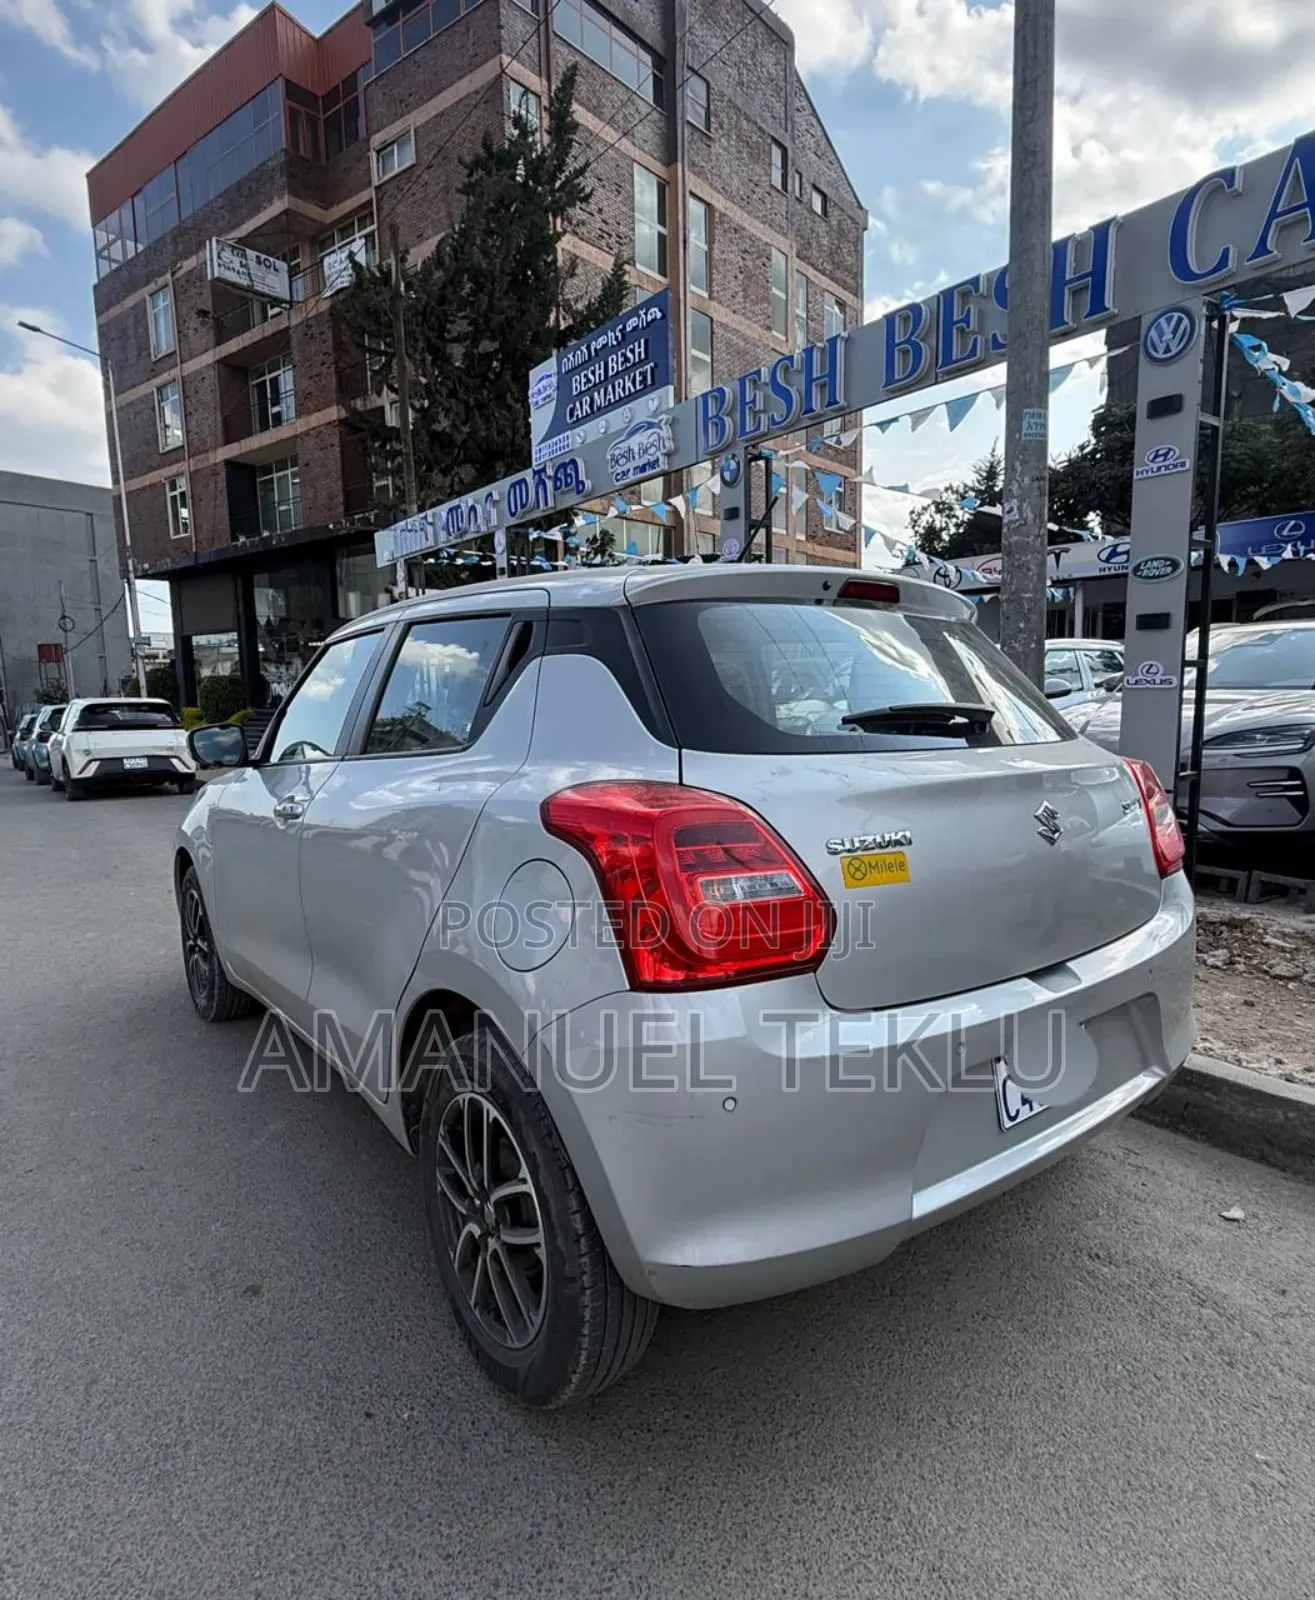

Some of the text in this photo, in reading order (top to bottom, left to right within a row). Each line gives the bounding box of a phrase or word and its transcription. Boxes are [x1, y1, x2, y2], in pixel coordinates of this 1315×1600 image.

[571, 360, 605, 396] BESH
[608, 338, 646, 377] BESH
[566, 395, 591, 424] CAR
[593, 362, 655, 412] MARKET
[700, 333, 846, 453] BESH
[614, 456, 660, 483] car market
[1135, 460, 1187, 477] HYUNDAI
[1140, 559, 1165, 570] LAND
[1141, 566, 1173, 578] ROVER
[1126, 678, 1174, 686] LEXUS
[825, 830, 913, 855] SUZUKI
[868, 858, 907, 875] Milele
